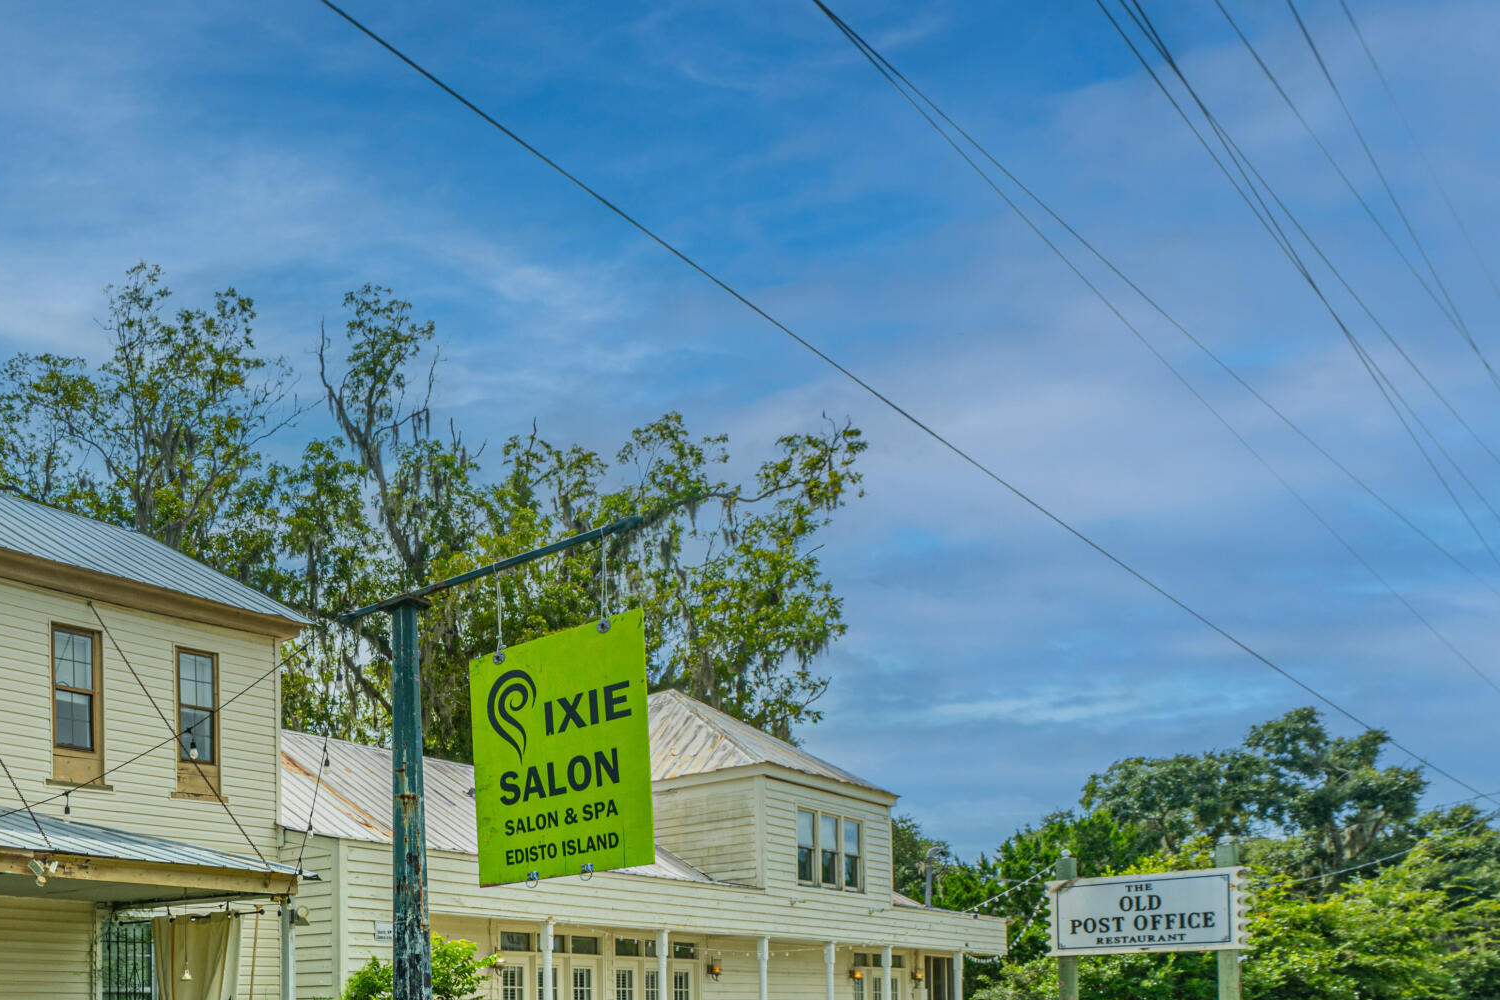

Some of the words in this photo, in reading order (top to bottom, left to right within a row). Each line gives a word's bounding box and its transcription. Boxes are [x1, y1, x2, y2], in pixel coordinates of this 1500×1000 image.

[500, 747, 619, 806] SALON
[505, 810, 559, 836] SALON
[564, 807, 578, 825] &
[582, 799, 619, 821] SPA
[505, 843, 557, 866] EDISTO
[562, 832, 619, 857] ISLAND
[1125, 883, 1153, 892] THE
[1119, 894, 1161, 912] OLD
[1069, 916, 1125, 935] POST
[1133, 911, 1216, 932] OFFICE
[1096, 933, 1187, 945] RESTAURANT
